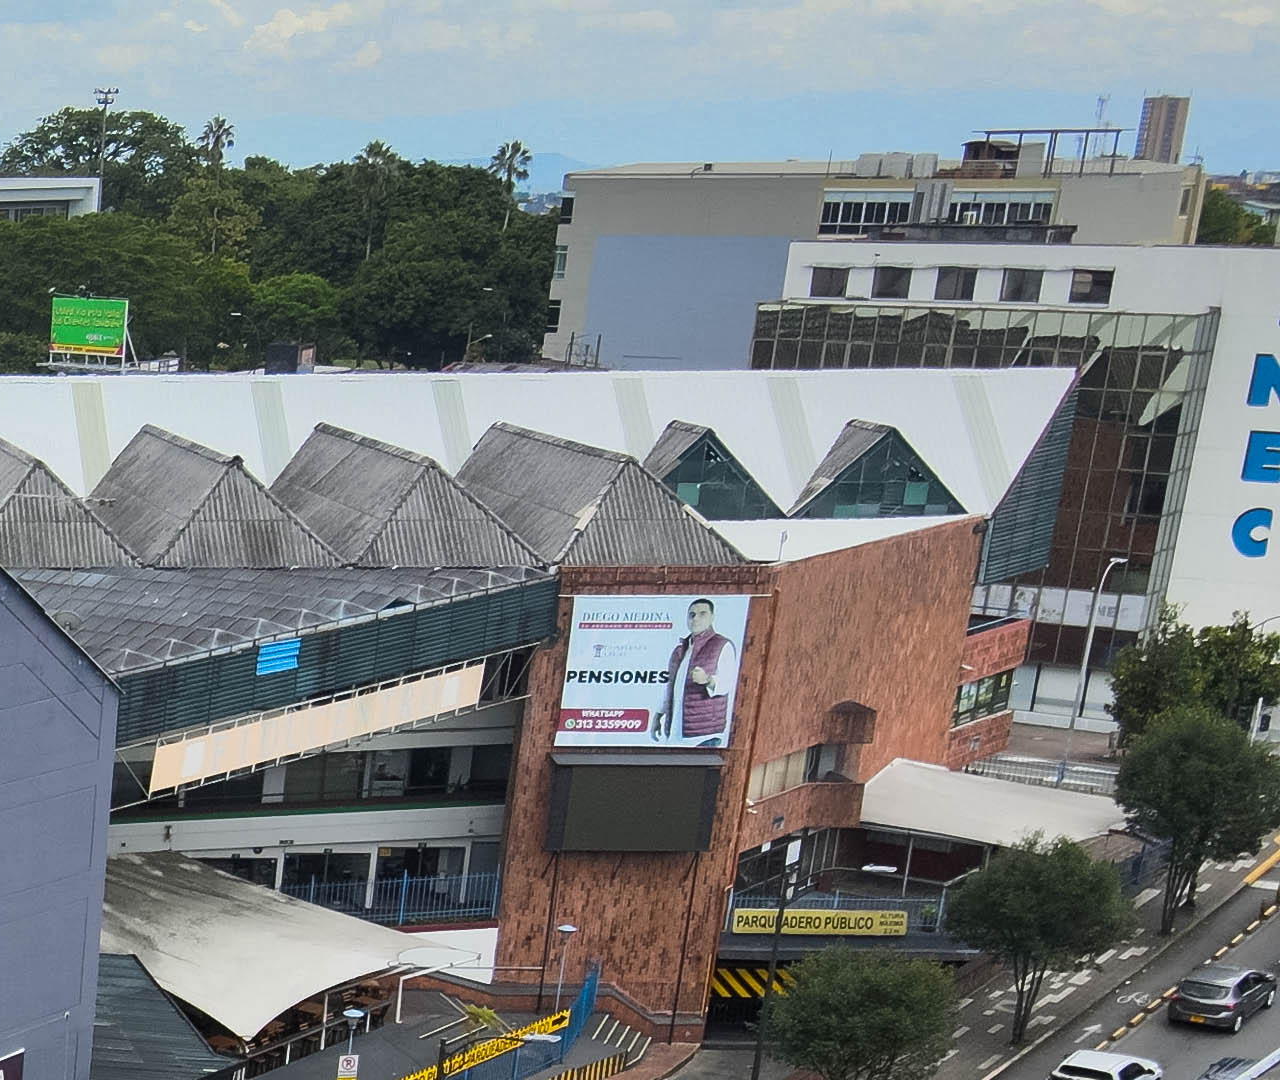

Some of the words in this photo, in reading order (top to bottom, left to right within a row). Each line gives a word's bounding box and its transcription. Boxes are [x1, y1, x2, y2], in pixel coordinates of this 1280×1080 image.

[1232, 318, 1280, 558] NEC
[566, 670, 670, 684] PENSIONES
[575, 719, 593, 729] 313
[595, 719, 642, 729] 3359909
[736, 915, 821, 930] PARQUADERO
[824, 913, 874, 930] PÚBLICO
